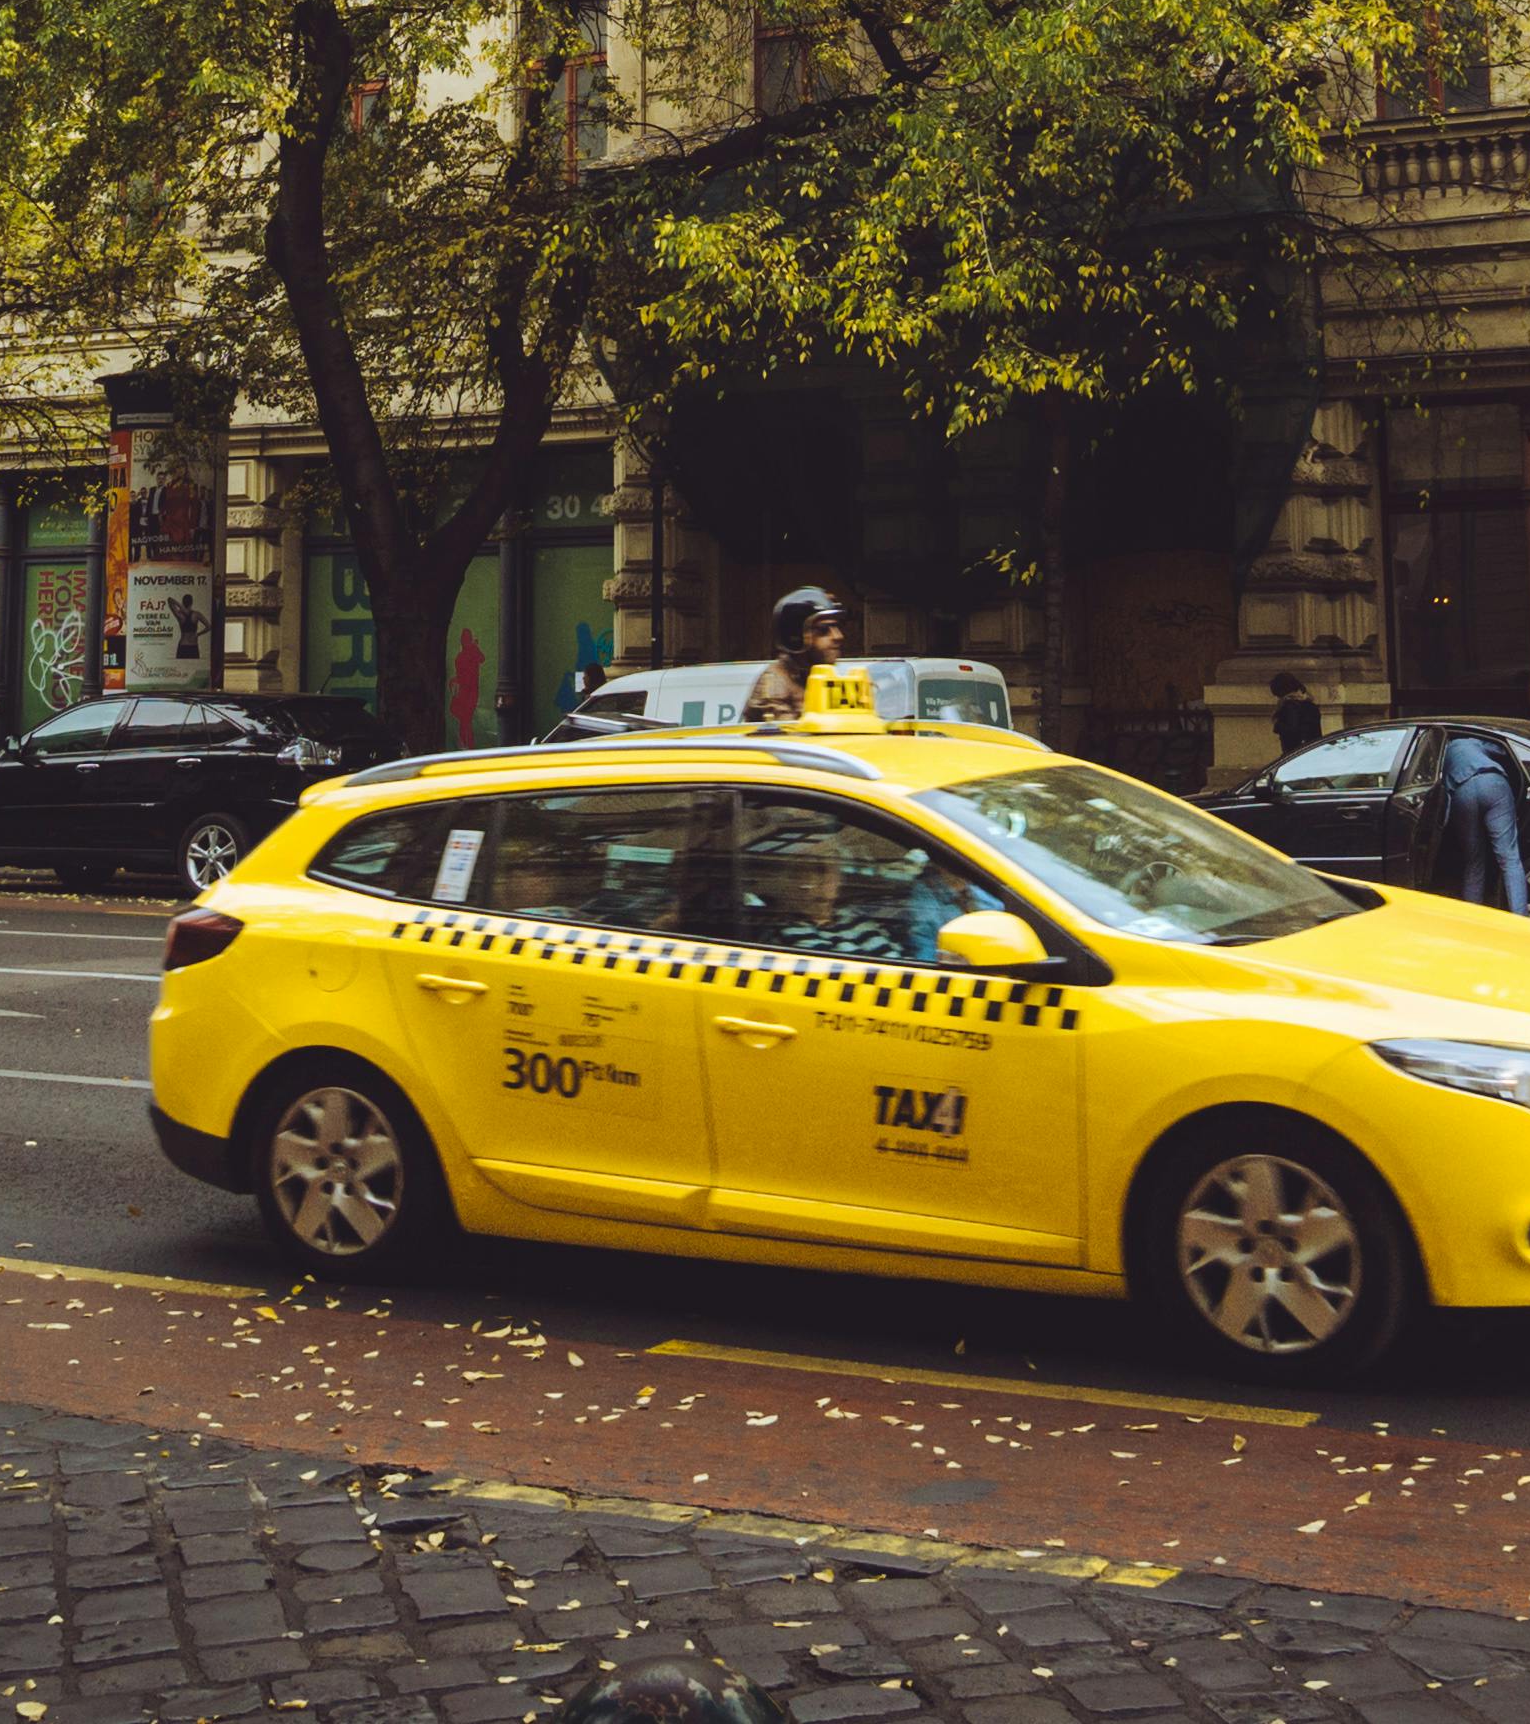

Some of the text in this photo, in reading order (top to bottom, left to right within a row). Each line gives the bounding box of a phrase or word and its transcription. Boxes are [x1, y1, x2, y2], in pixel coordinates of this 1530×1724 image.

[134, 575, 207, 586] NOVEMBER 17.
[140, 598, 166, 611] FÁJ?
[502, 1047, 582, 1098] 300
